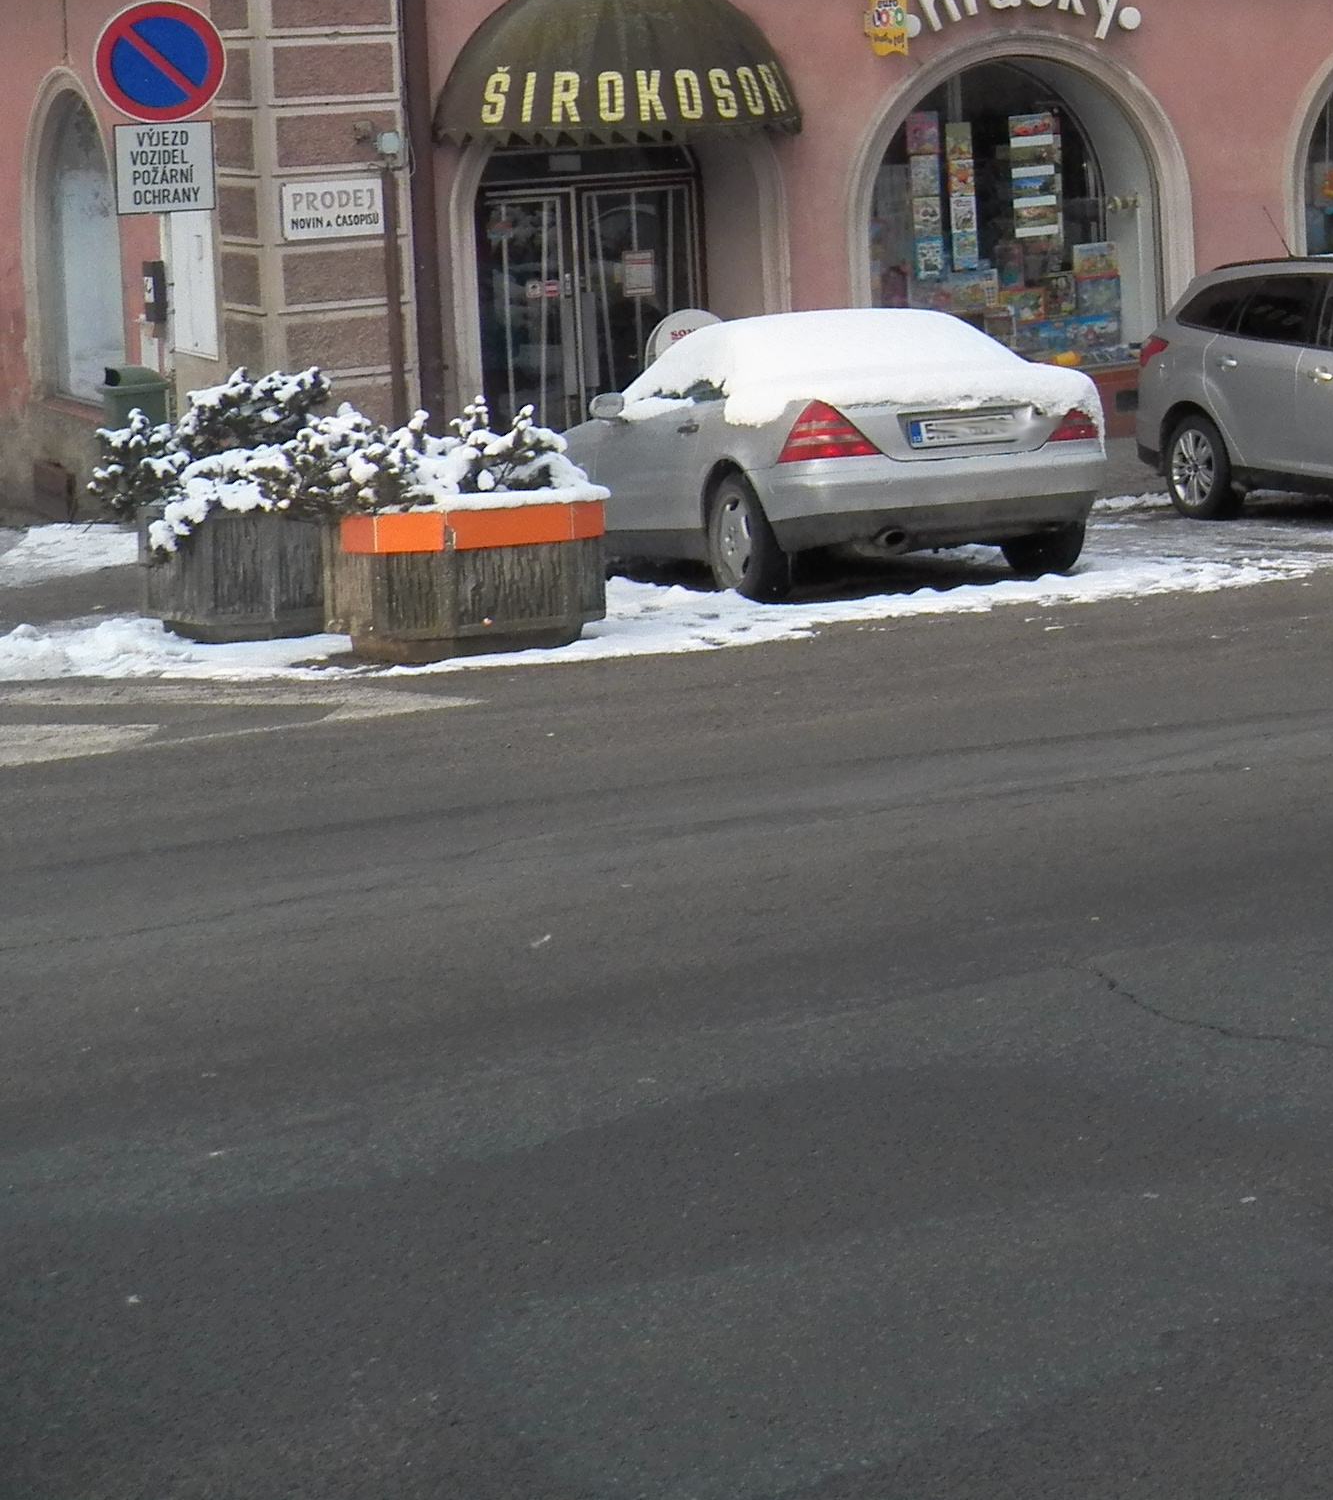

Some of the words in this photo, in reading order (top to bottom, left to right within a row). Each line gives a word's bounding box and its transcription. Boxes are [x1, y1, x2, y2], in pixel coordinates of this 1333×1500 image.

[136, 128, 190, 147] VÝJEZD
[130, 148, 190, 166] VOZIDEL
[132, 164, 194, 186] POŽÁRNÍ
[133, 186, 201, 206] OCHRANY
[291, 188, 376, 211] PRODEJ
[291, 217, 324, 230] NOVIN
[335, 211, 379, 228] ČASOPISŮ
